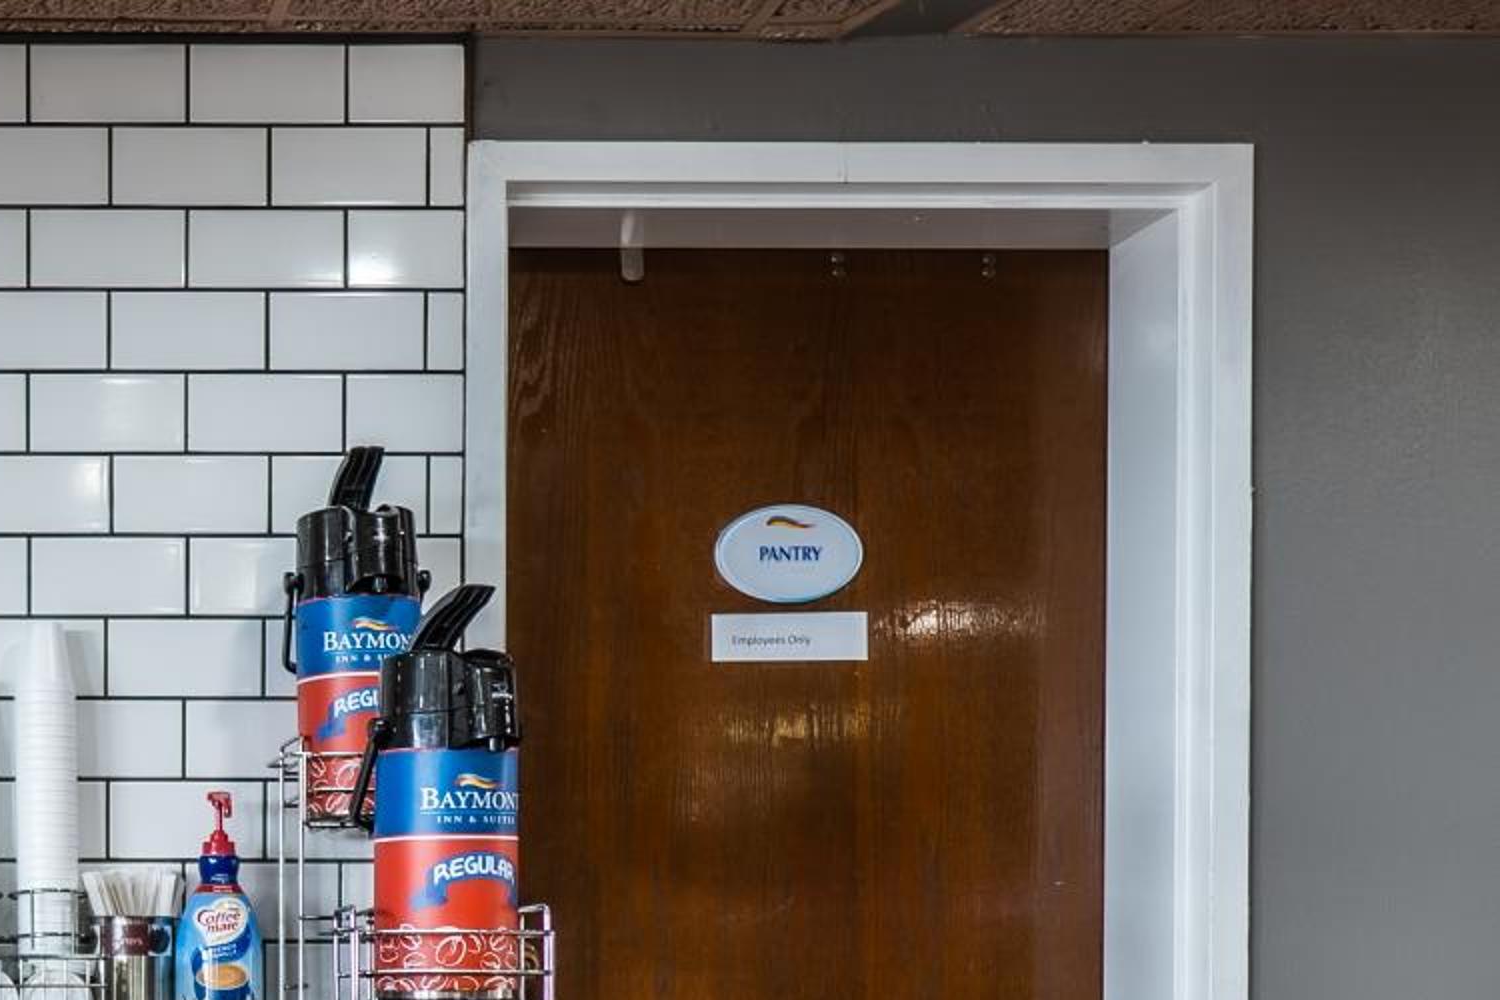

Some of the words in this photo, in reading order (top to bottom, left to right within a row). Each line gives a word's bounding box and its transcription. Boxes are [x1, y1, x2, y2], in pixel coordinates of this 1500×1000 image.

[759, 545, 822, 561] PANTRY
[323, 631, 411, 652] BAYMON
[731, 634, 785, 647] Employees
[787, 634, 811, 647] Only
[436, 815, 462, 824] INN
